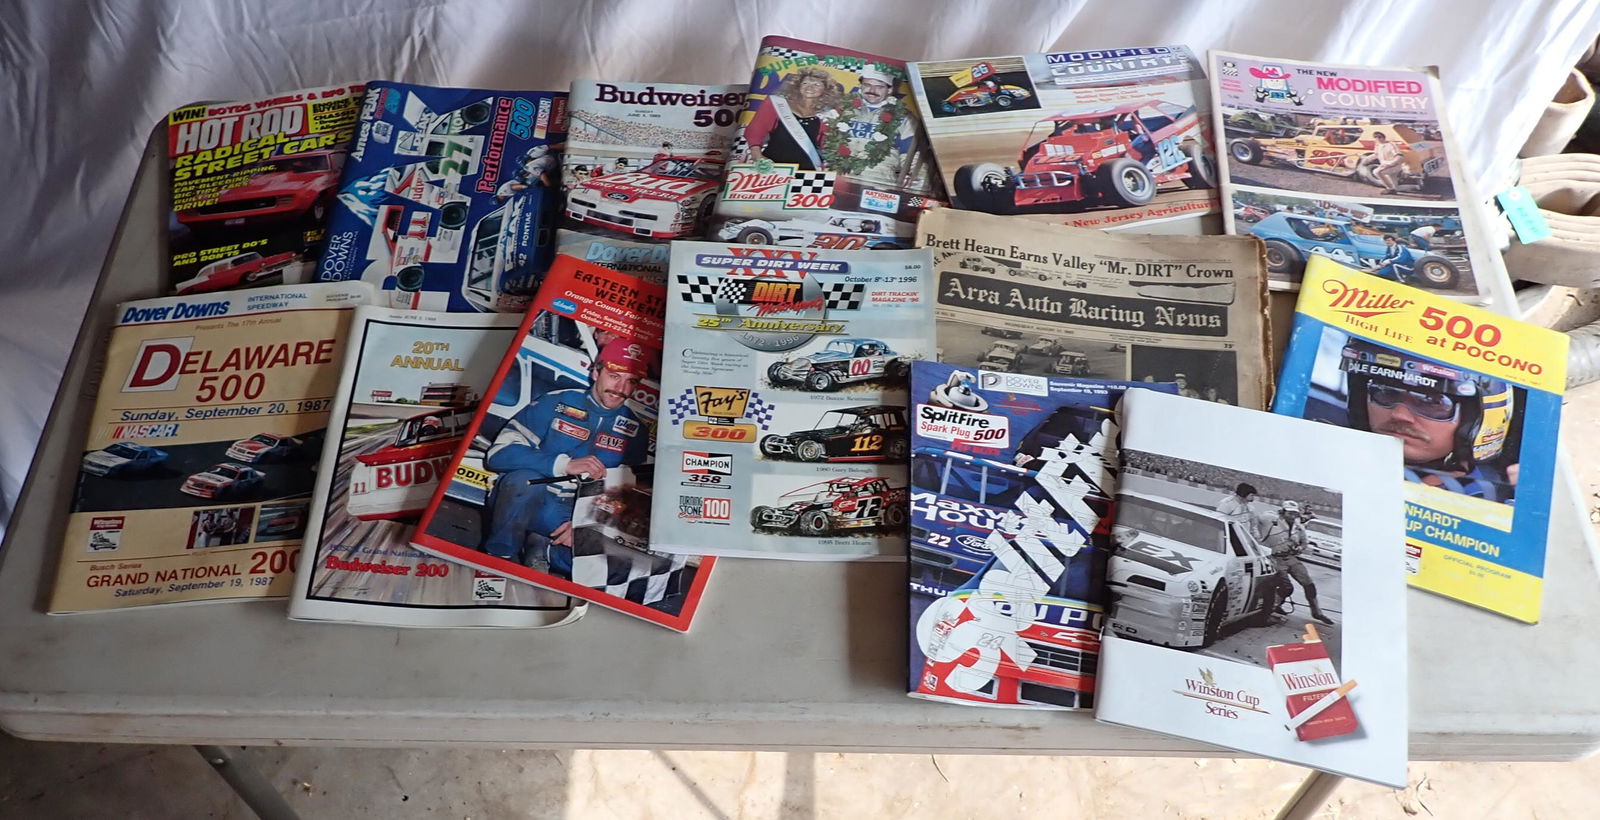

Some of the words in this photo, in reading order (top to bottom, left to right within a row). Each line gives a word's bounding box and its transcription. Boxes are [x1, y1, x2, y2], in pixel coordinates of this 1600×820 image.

[758, 55, 818, 75] SUPER
[825, 55, 867, 68] DIRT
[1047, 47, 1170, 64] MODIFIED
[972, 64, 989, 78] 26
[1050, 56, 1172, 76] COUNTRY
[595, 83, 749, 107] Budweiser
[1316, 77, 1422, 94] MODIFIED
[1321, 92, 1428, 109] COUNTRY
[173, 107, 206, 122] WIN!
[510, 97, 534, 140] 500
[176, 116, 239, 155] HOT
[240, 106, 304, 143] ROD
[175, 131, 290, 169] RADICAL
[477, 97, 513, 192] Performance
[174, 145, 276, 181] STREET
[283, 130, 353, 155] CARS
[595, 172, 704, 194] Bud
[727, 172, 797, 192] Miller
[173, 198, 220, 213] DRIVE!
[786, 193, 836, 208] 300
[1073, 218, 1100, 227] New
[1101, 211, 1143, 225] Jersey
[521, 212, 533, 247] PONTIAC
[200, 244, 240, 256] STREET
[320, 234, 343, 281] DOVER
[332, 231, 353, 282] DOWNS
[586, 242, 650, 262] Dover
[926, 234, 960, 250] Brett
[964, 238, 1006, 257] Hearn
[1010, 246, 1049, 265] Earns
[1052, 253, 1096, 274] Valley
[1186, 264, 1234, 278] Crown
[173, 257, 198, 267] AND
[701, 256, 753, 266] SUPER
[757, 259, 793, 269] DIRT
[797, 261, 841, 271] WEEK
[574, 270, 640, 299] EASTERN
[751, 282, 802, 303] DIRT
[1323, 279, 1415, 310] Miller
[121, 307, 174, 324] Dover
[172, 301, 231, 320] Downs
[248, 293, 308, 303] INTERNATIONAL
[247, 302, 289, 311] SPEEDWAY
[564, 290, 594, 304] Orange
[595, 300, 624, 315] County
[625, 310, 641, 320] Fair
[944, 278, 1001, 305] Area
[1004, 289, 1063, 315] Auto
[1069, 298, 1145, 328] Racing
[1155, 305, 1222, 328] News
[580, 313, 603, 326] October
[583, 308, 602, 319] Friday,
[604, 315, 629, 327] Saturday
[697, 318, 732, 328] 25th
[738, 318, 845, 333] Anniversary
[1419, 306, 1502, 347] 500
[1345, 314, 1379, 333] HIGH
[1384, 328, 1414, 344] LIFE
[412, 341, 450, 355] 20TH
[775, 335, 800, 348] 1996
[129, 339, 336, 388] DELAWARE
[390, 355, 464, 371] ANNUAL
[1426, 334, 1447, 348] at
[1452, 342, 1543, 376] POCONO
[852, 359, 871, 376] 00
[1370, 366, 1439, 388] EARNHARDT
[195, 372, 265, 403] 500
[121, 410, 179, 422] Sunday,
[185, 404, 262, 420] September
[268, 403, 289, 415] 20,
[296, 400, 331, 411] 1987
[699, 390, 747, 414] Fay's
[920, 406, 990, 429] SplitFire
[122, 424, 180, 438] NASCAR
[692, 426, 747, 440] 300
[920, 421, 948, 434] Spark
[950, 426, 971, 438] Plug
[973, 428, 1006, 441] 500
[850, 434, 884, 453] 112
[685, 458, 730, 469] CHAMPION
[353, 482, 367, 494] 11
[688, 474, 722, 484] 358
[679, 504, 702, 515] STONE
[704, 499, 730, 519] 100
[855, 497, 881, 519] 72
[927, 532, 951, 547] 22
[1424, 525, 1500, 558] CHAMPION
[87, 572, 149, 588] GRAND
[155, 563, 241, 583] NATIONAL
[325, 556, 411, 577] Budweiser
[415, 563, 449, 578] 200
[114, 586, 163, 598] Saturday,
[168, 579, 225, 593] September
[230, 578, 244, 587] 19,
[250, 576, 274, 586] 1987
[1282, 672, 1336, 691] Winston
[1185, 679, 1235, 700] Winston
[1236, 690, 1260, 709] Cup
[1205, 702, 1239, 720] Series
